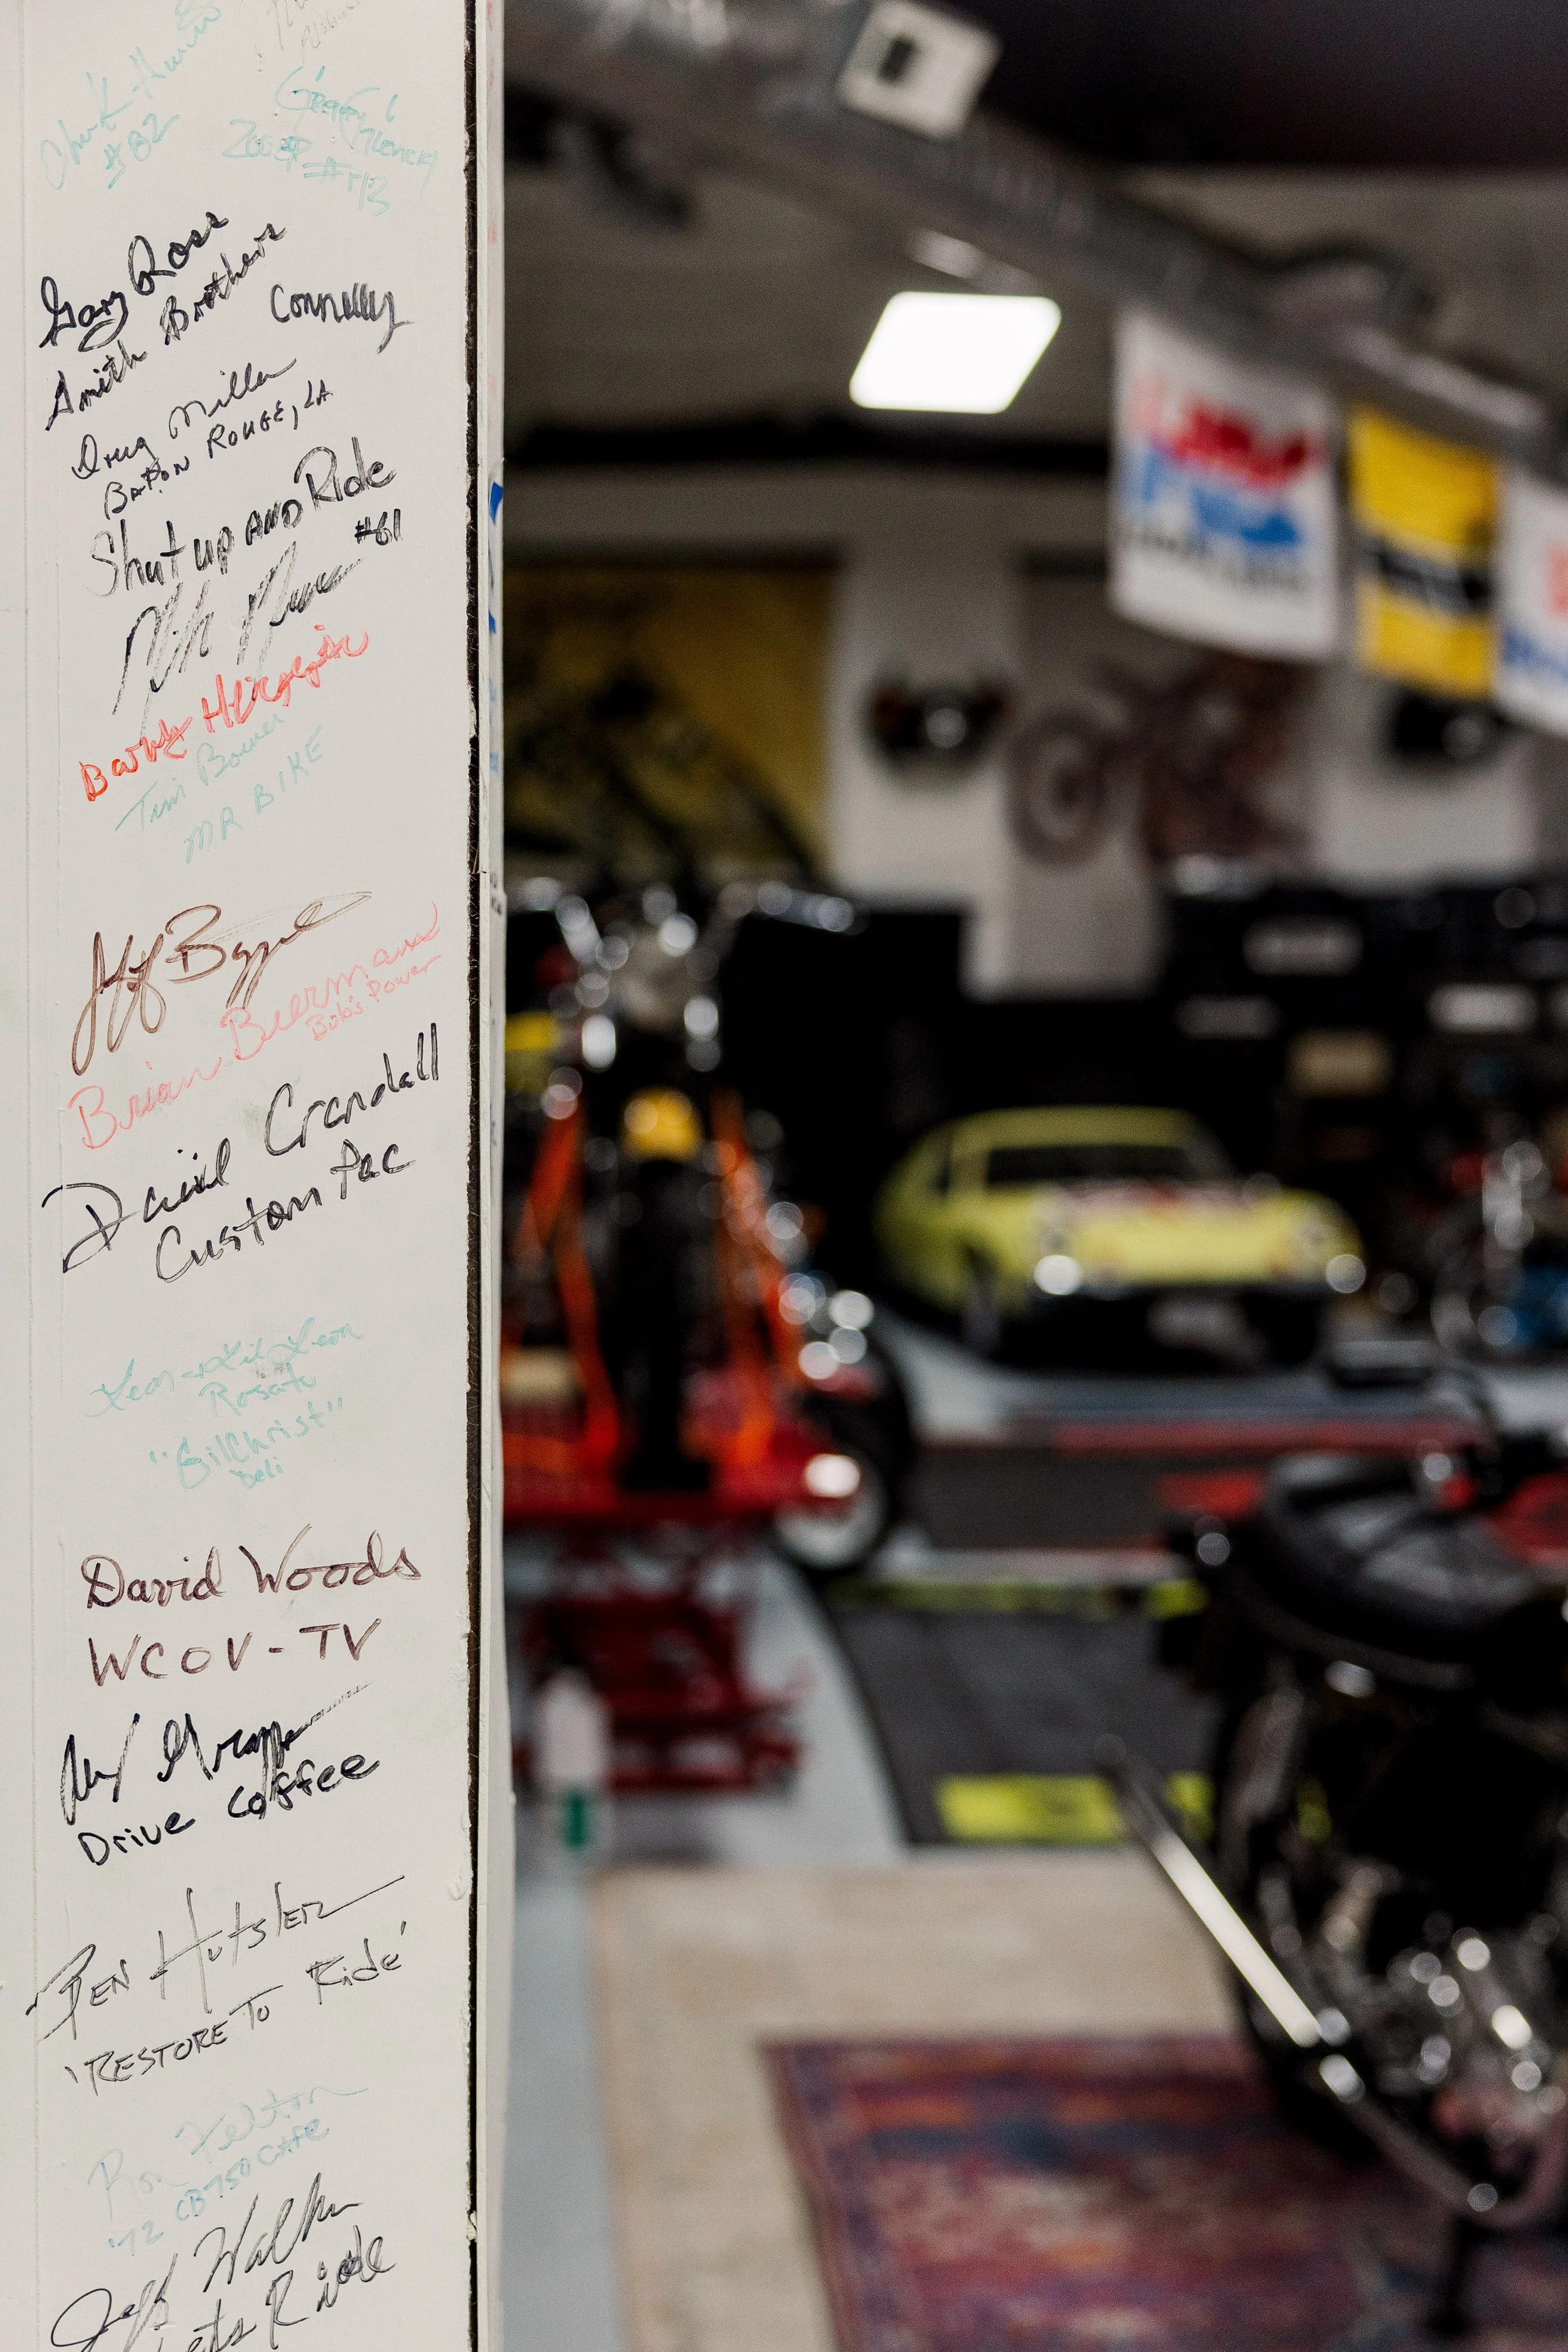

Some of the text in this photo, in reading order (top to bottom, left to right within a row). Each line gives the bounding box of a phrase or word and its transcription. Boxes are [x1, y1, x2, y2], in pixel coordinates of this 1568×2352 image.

[40, 276, 129, 352] Gary
[159, 223, 287, 345] Brothers
[305, 379, 334, 406] LA
[84, 519, 186, 597] Shut
[246, 499, 304, 545] AND
[294, 436, 398, 511] Ride
[354, 509, 402, 545] #61
[253, 724, 324, 816] BIKE
[68, 1056, 222, 1150] Brian
[81, 1523, 423, 1609] David Woods
[77, 1811, 196, 1866] Drive
